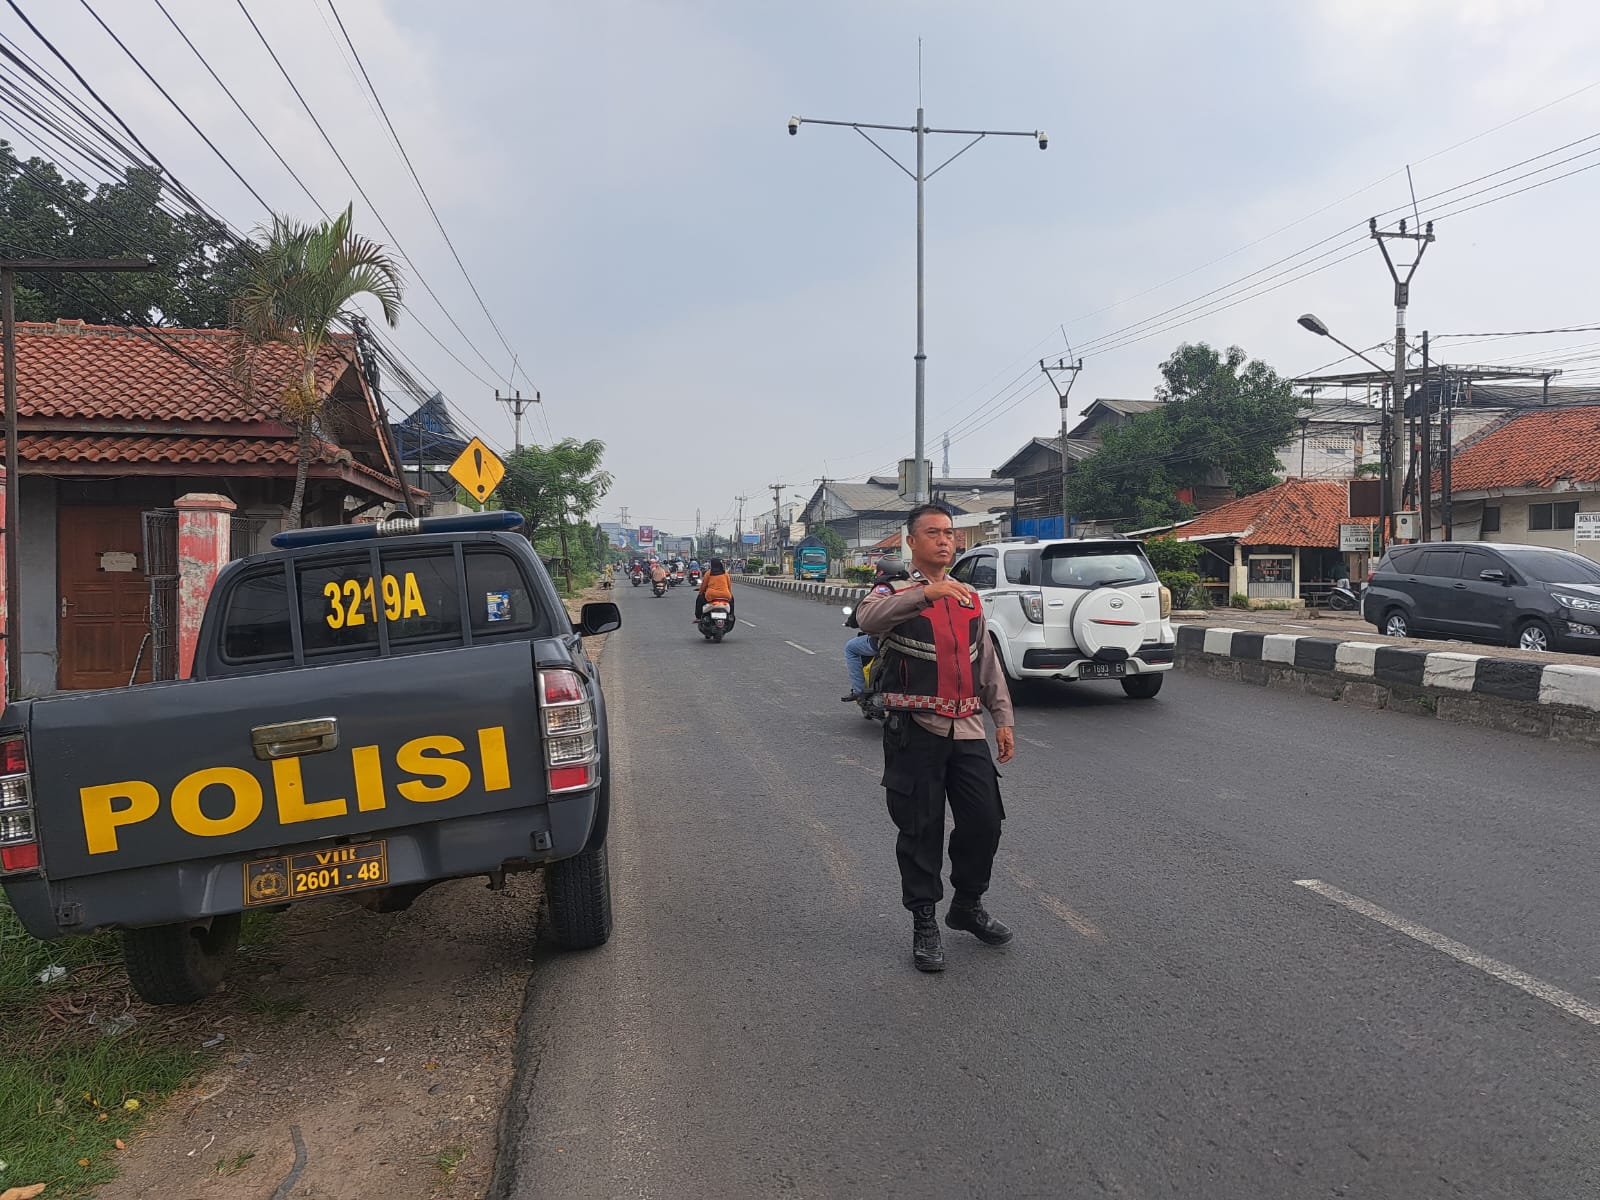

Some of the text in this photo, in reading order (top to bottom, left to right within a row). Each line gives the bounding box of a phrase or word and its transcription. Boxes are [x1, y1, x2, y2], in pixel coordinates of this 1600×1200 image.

[323, 571, 427, 629] 3219A
[1093, 663, 1109, 673] 1693
[79, 726, 511, 854] POLISI
[296, 867, 340, 892] 2601
[357, 861, 380, 881] 48
